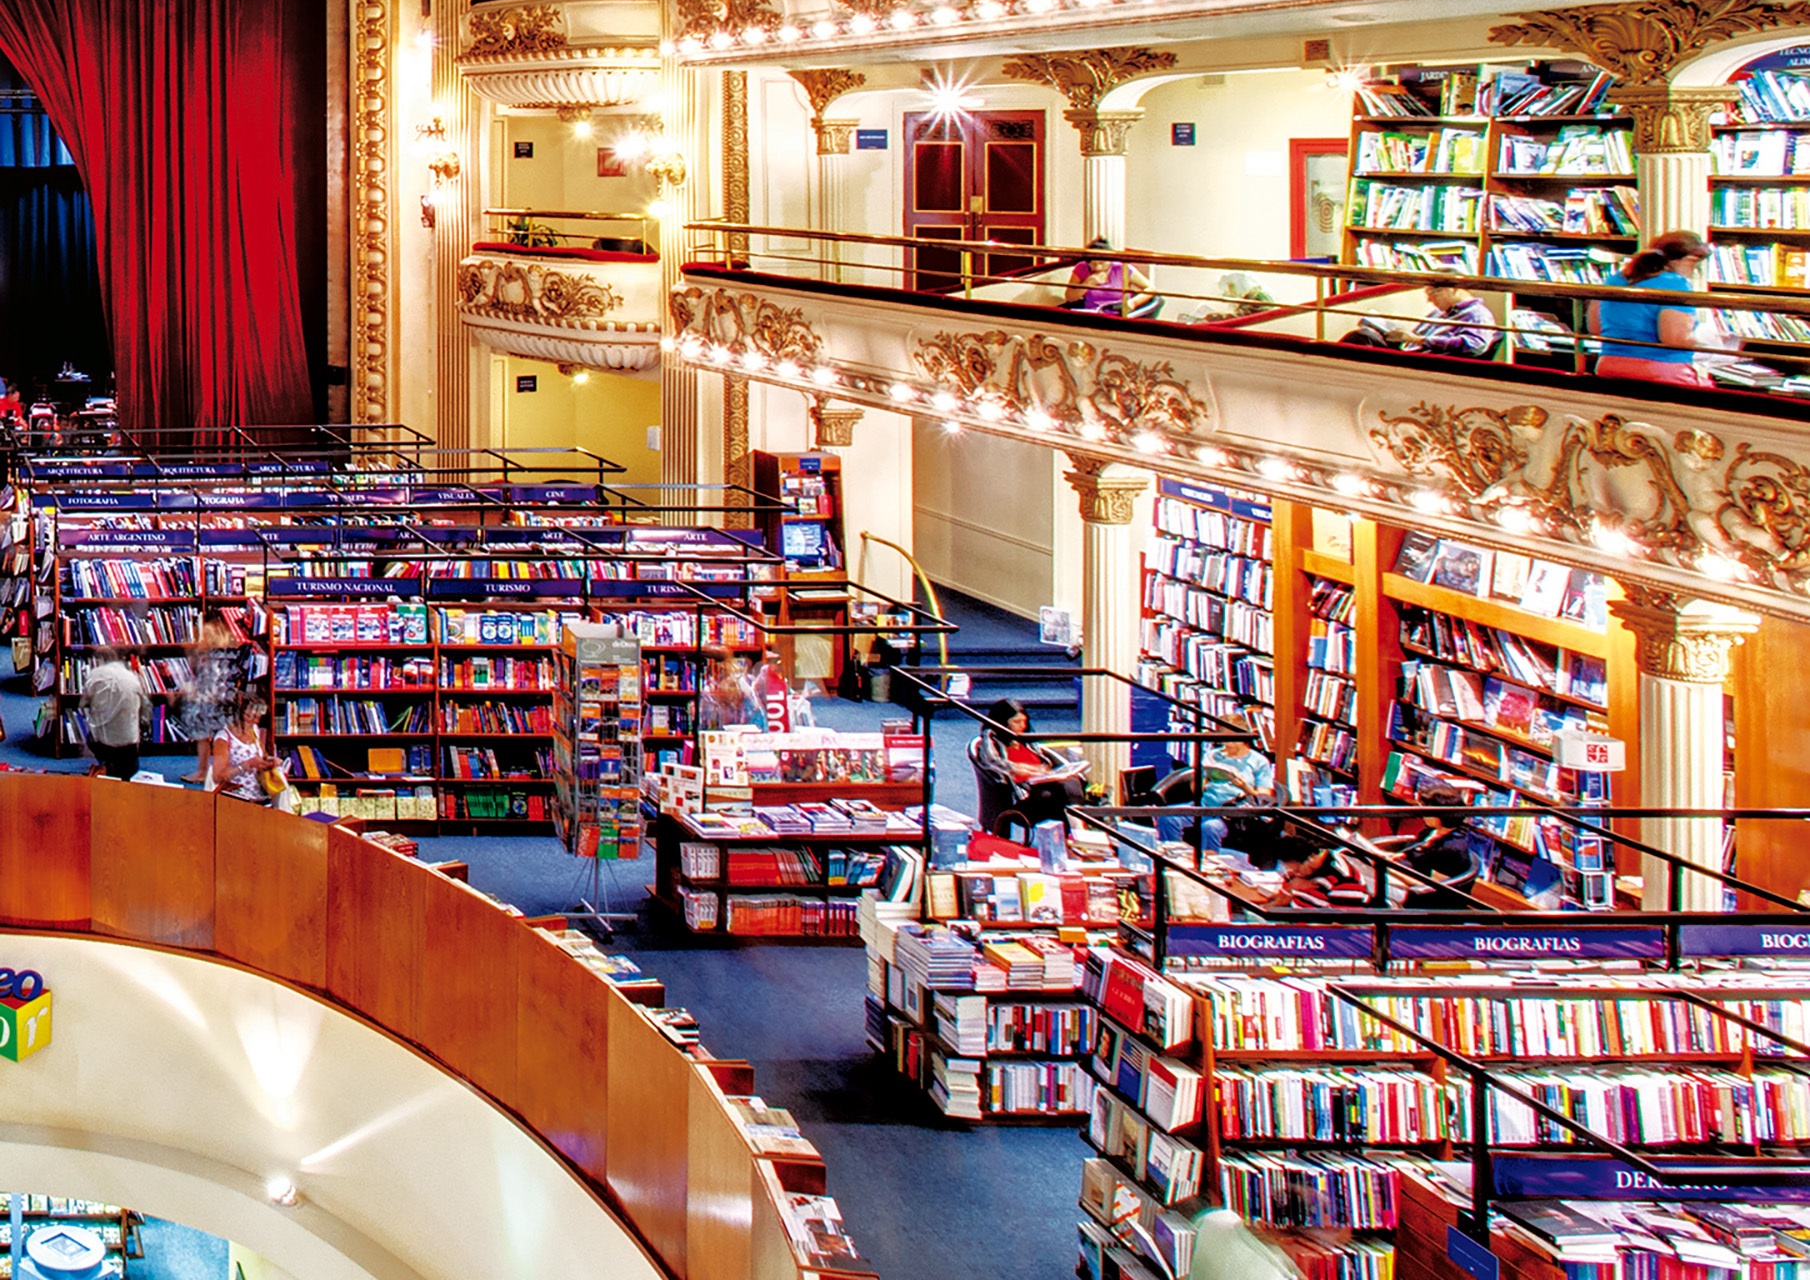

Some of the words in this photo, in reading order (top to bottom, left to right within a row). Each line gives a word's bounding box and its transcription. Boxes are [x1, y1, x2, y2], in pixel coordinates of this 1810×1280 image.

[46, 468, 103, 477] ARQUITECTURA
[545, 490, 566, 498] CINE
[193, 496, 245, 505] FTOGRAFIA
[88, 533, 111, 541] ARTE
[113, 533, 166, 542] ARGENTINO
[256, 532, 280, 541] RTE
[541, 531, 564, 540] ARTE
[684, 532, 708, 541] ARTE
[296, 581, 342, 592] TURISMO
[344, 583, 396, 593] NACIONAL
[484, 582, 531, 593] TURISMO
[646, 584, 688, 594] TURISM
[1218, 933, 1325, 951] BIOGRAFIAS
[1474, 935, 1581, 952] BIOGRAFIAS
[1761, 933, 1810, 949] BIOG
